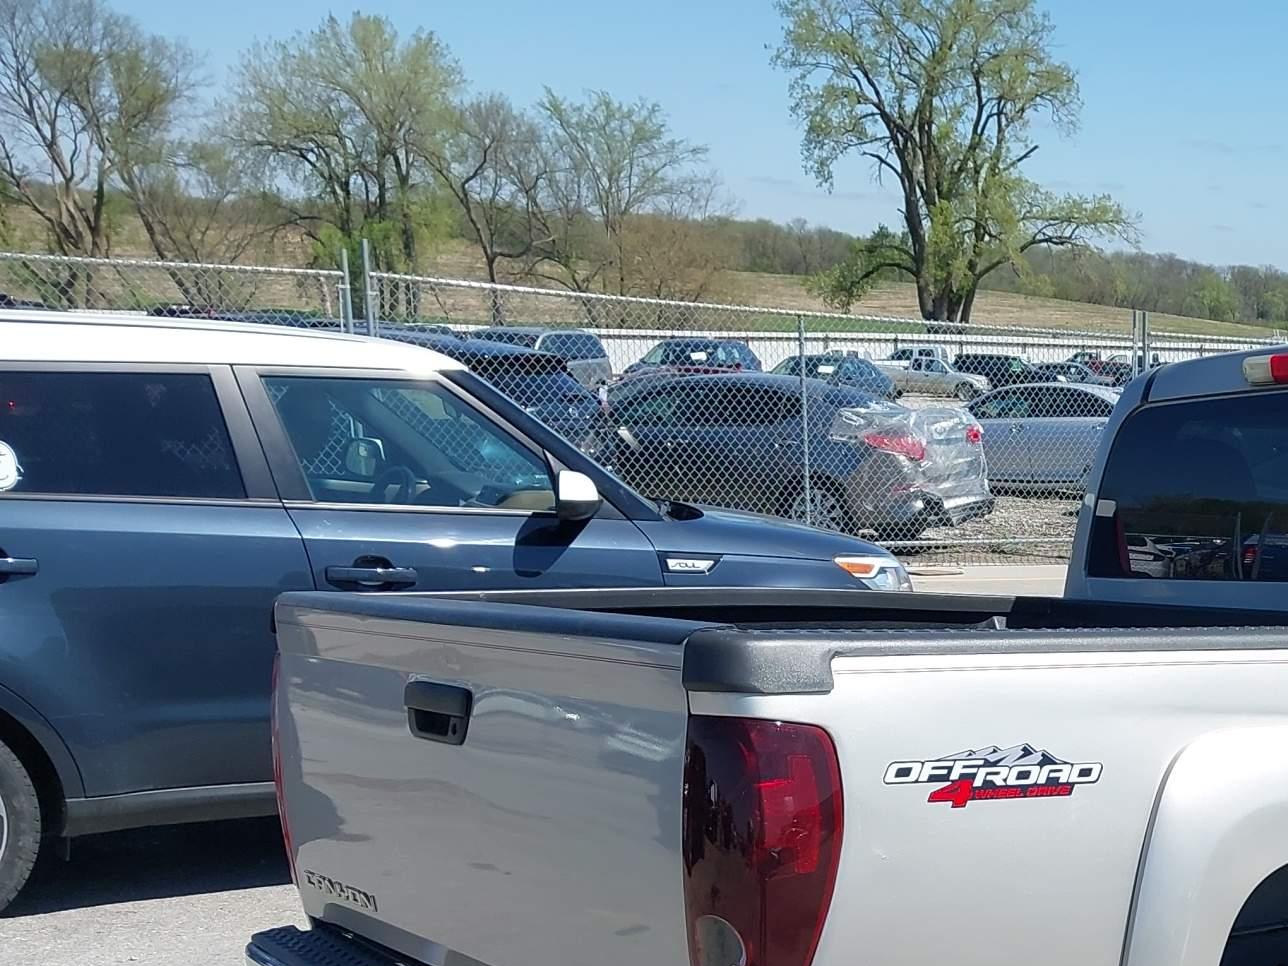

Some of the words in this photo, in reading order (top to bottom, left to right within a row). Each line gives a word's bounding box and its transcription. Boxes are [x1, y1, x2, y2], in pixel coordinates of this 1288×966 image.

[927, 779, 974, 808] 4
[974, 787, 1025, 800] WHEEL
[1026, 785, 1072, 797] DRIVE
